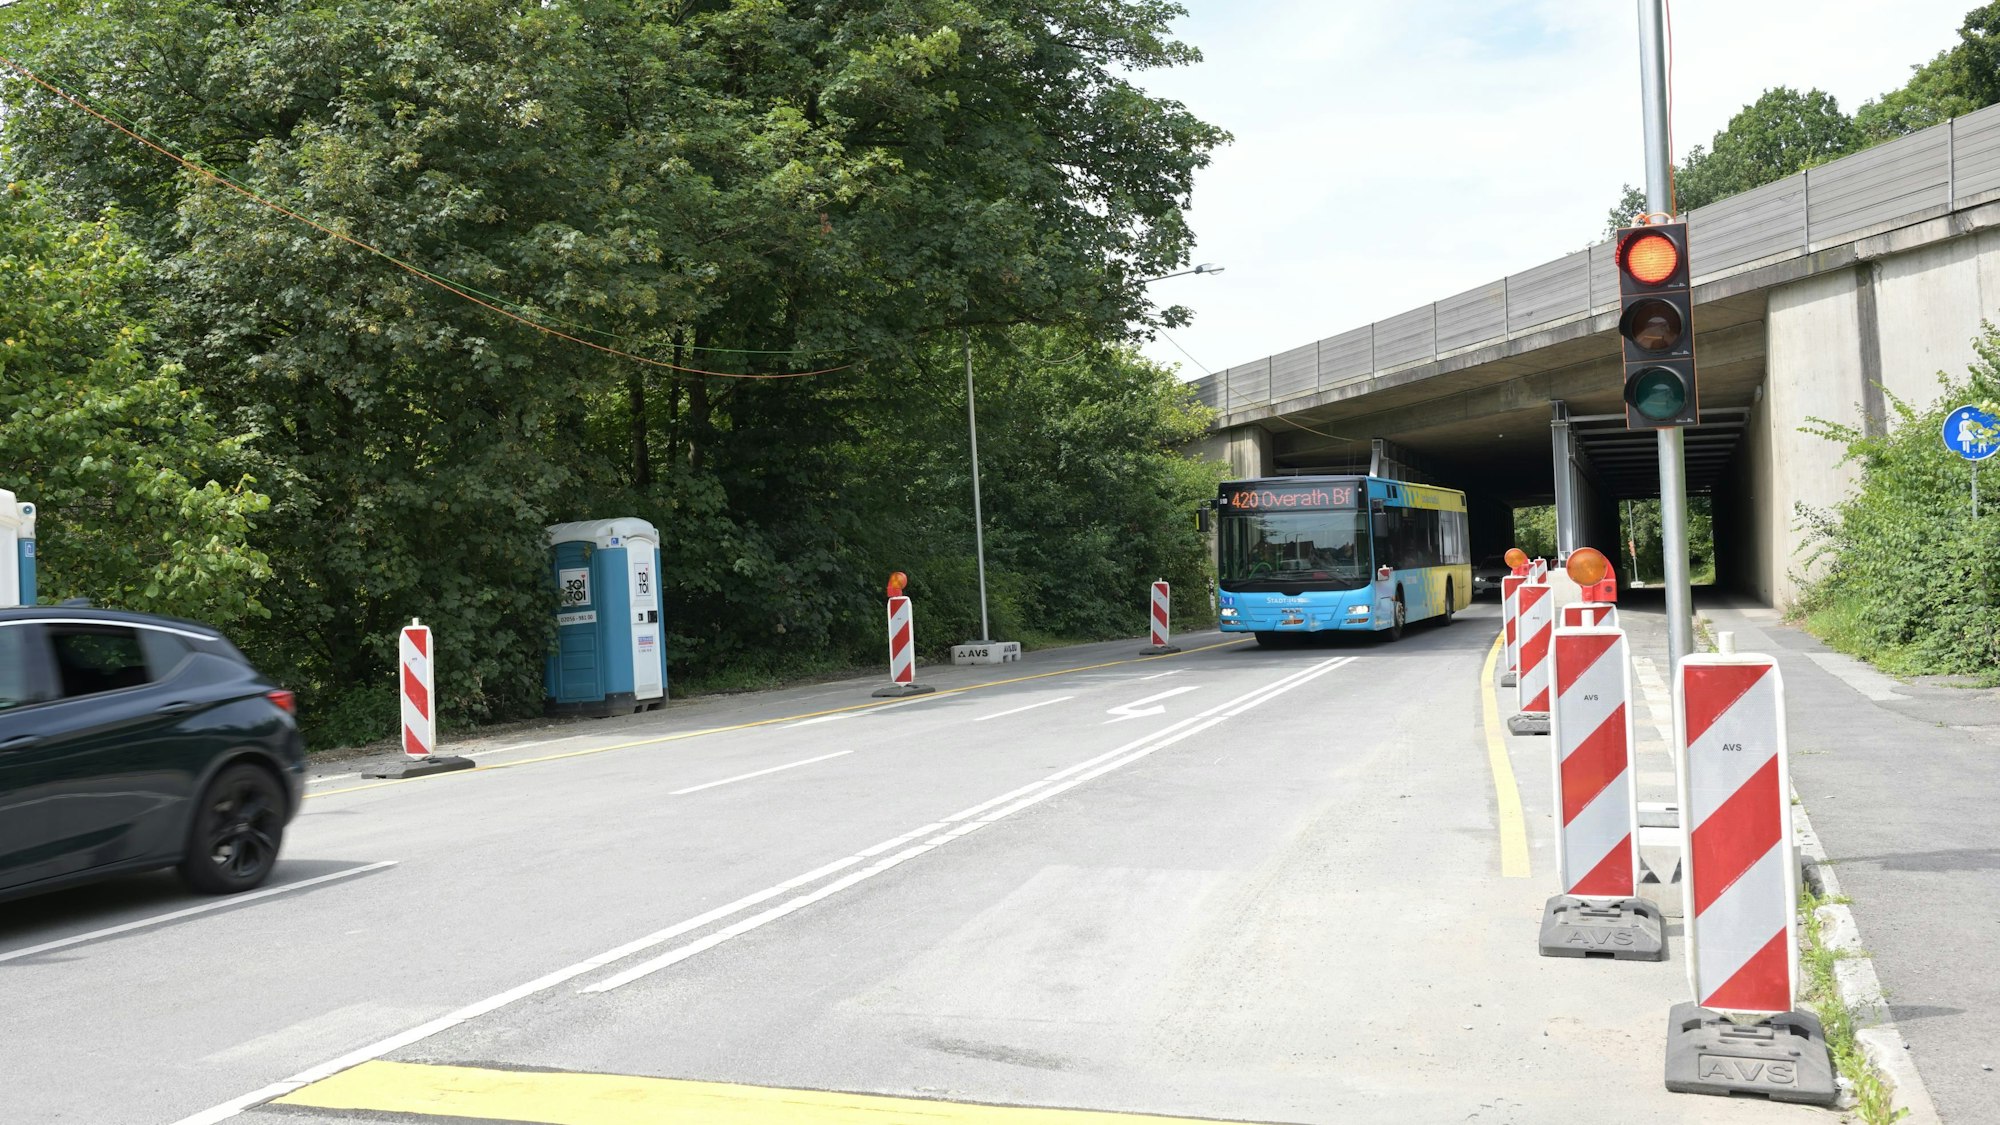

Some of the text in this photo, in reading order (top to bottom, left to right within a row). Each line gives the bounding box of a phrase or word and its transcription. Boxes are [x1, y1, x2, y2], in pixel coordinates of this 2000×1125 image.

[1231, 487, 1352, 509] 420 Overath Bf
[638, 572, 649, 583] TOI
[566, 579, 586, 590] TOI
[638, 583, 649, 594] TOI
[968, 649, 988, 657] AVS
[1722, 743, 1742, 752] AVS
[1566, 931, 1634, 946] AVS
[1701, 1060, 1795, 1085] AVS
